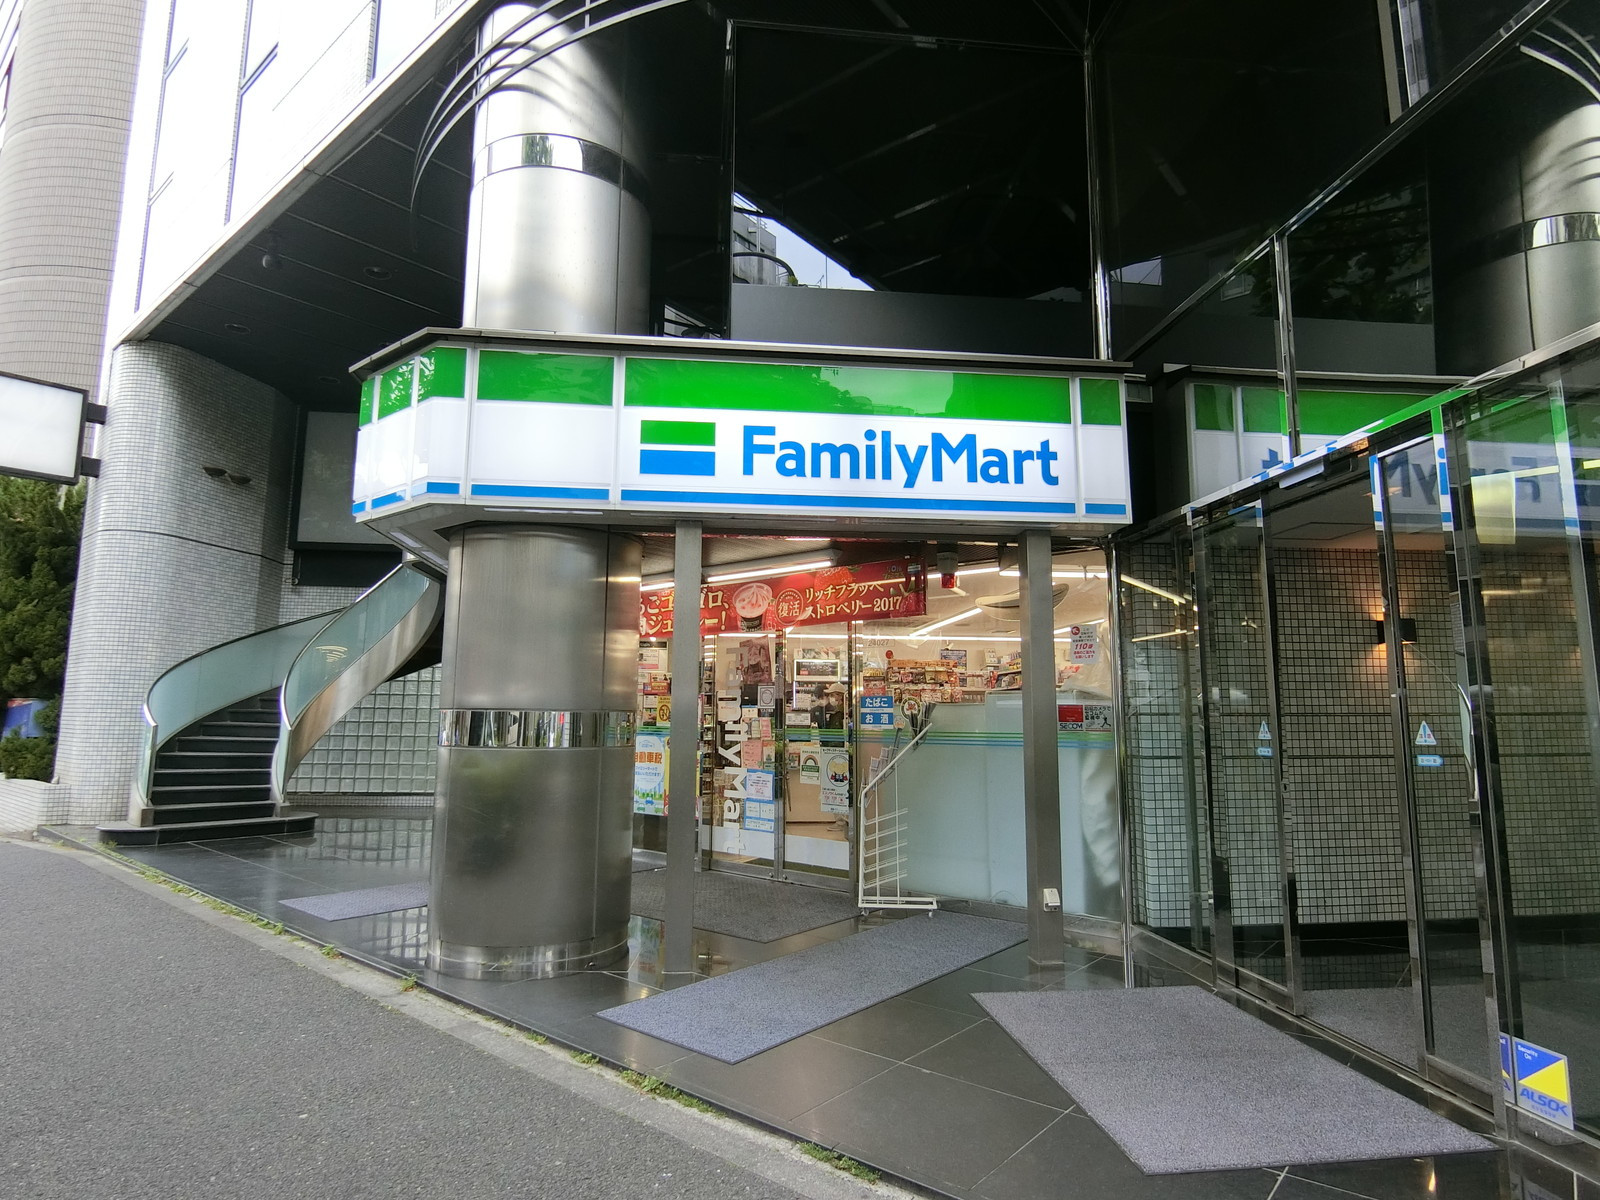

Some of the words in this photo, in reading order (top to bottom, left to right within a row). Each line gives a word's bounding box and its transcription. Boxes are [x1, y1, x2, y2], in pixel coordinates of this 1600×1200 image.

[743, 425, 1059, 489] FamilyMart
[778, 600, 800, 618] 復活
[805, 596, 903, 620] ストロベリー2017
[865, 697, 889, 708] たばこ
[1520, 1088, 1569, 1117] ALSOK
